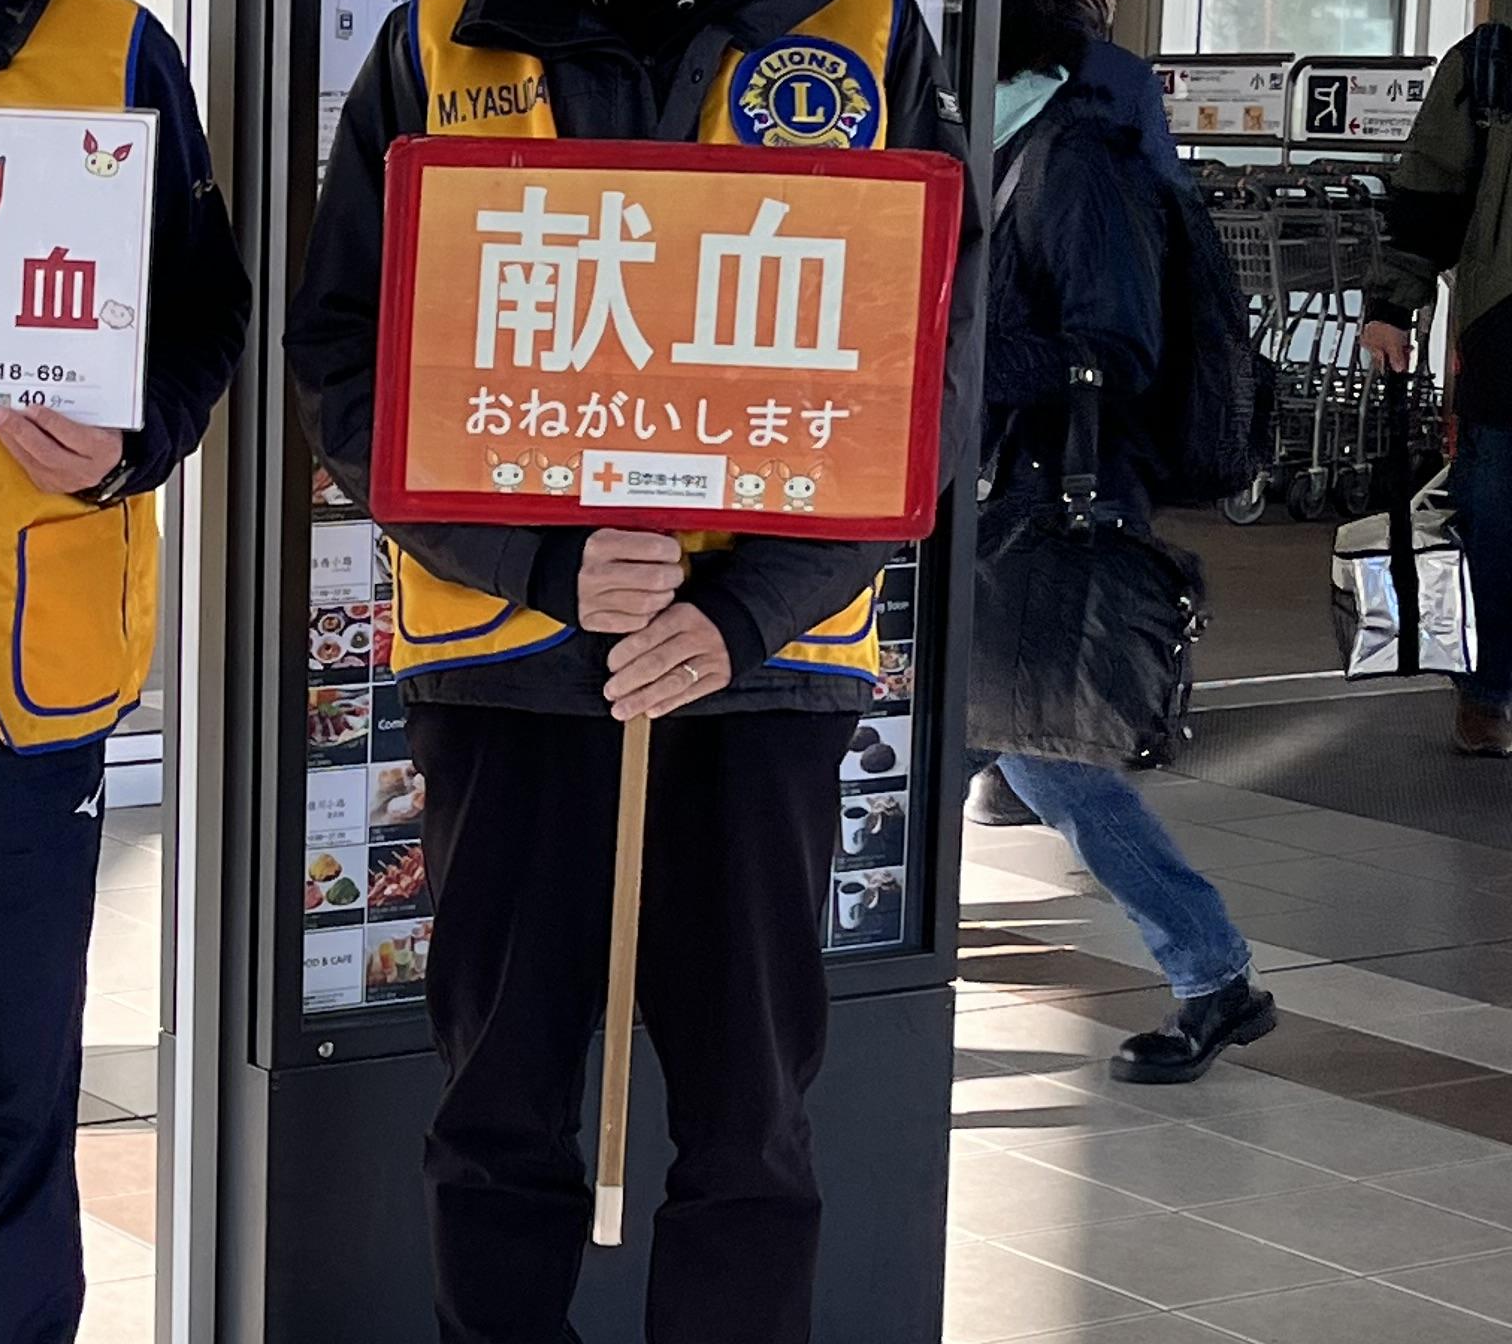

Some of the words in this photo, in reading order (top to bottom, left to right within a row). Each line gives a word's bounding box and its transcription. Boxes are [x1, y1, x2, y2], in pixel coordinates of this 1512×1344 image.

[764, 51, 841, 74] LIONS
[790, 82, 825, 123] L
[1386, 79, 1424, 103] 小型
[15, 246, 99, 330] 血
[474, 186, 859, 372] 献血
[465, 385, 850, 449] おねがいします
